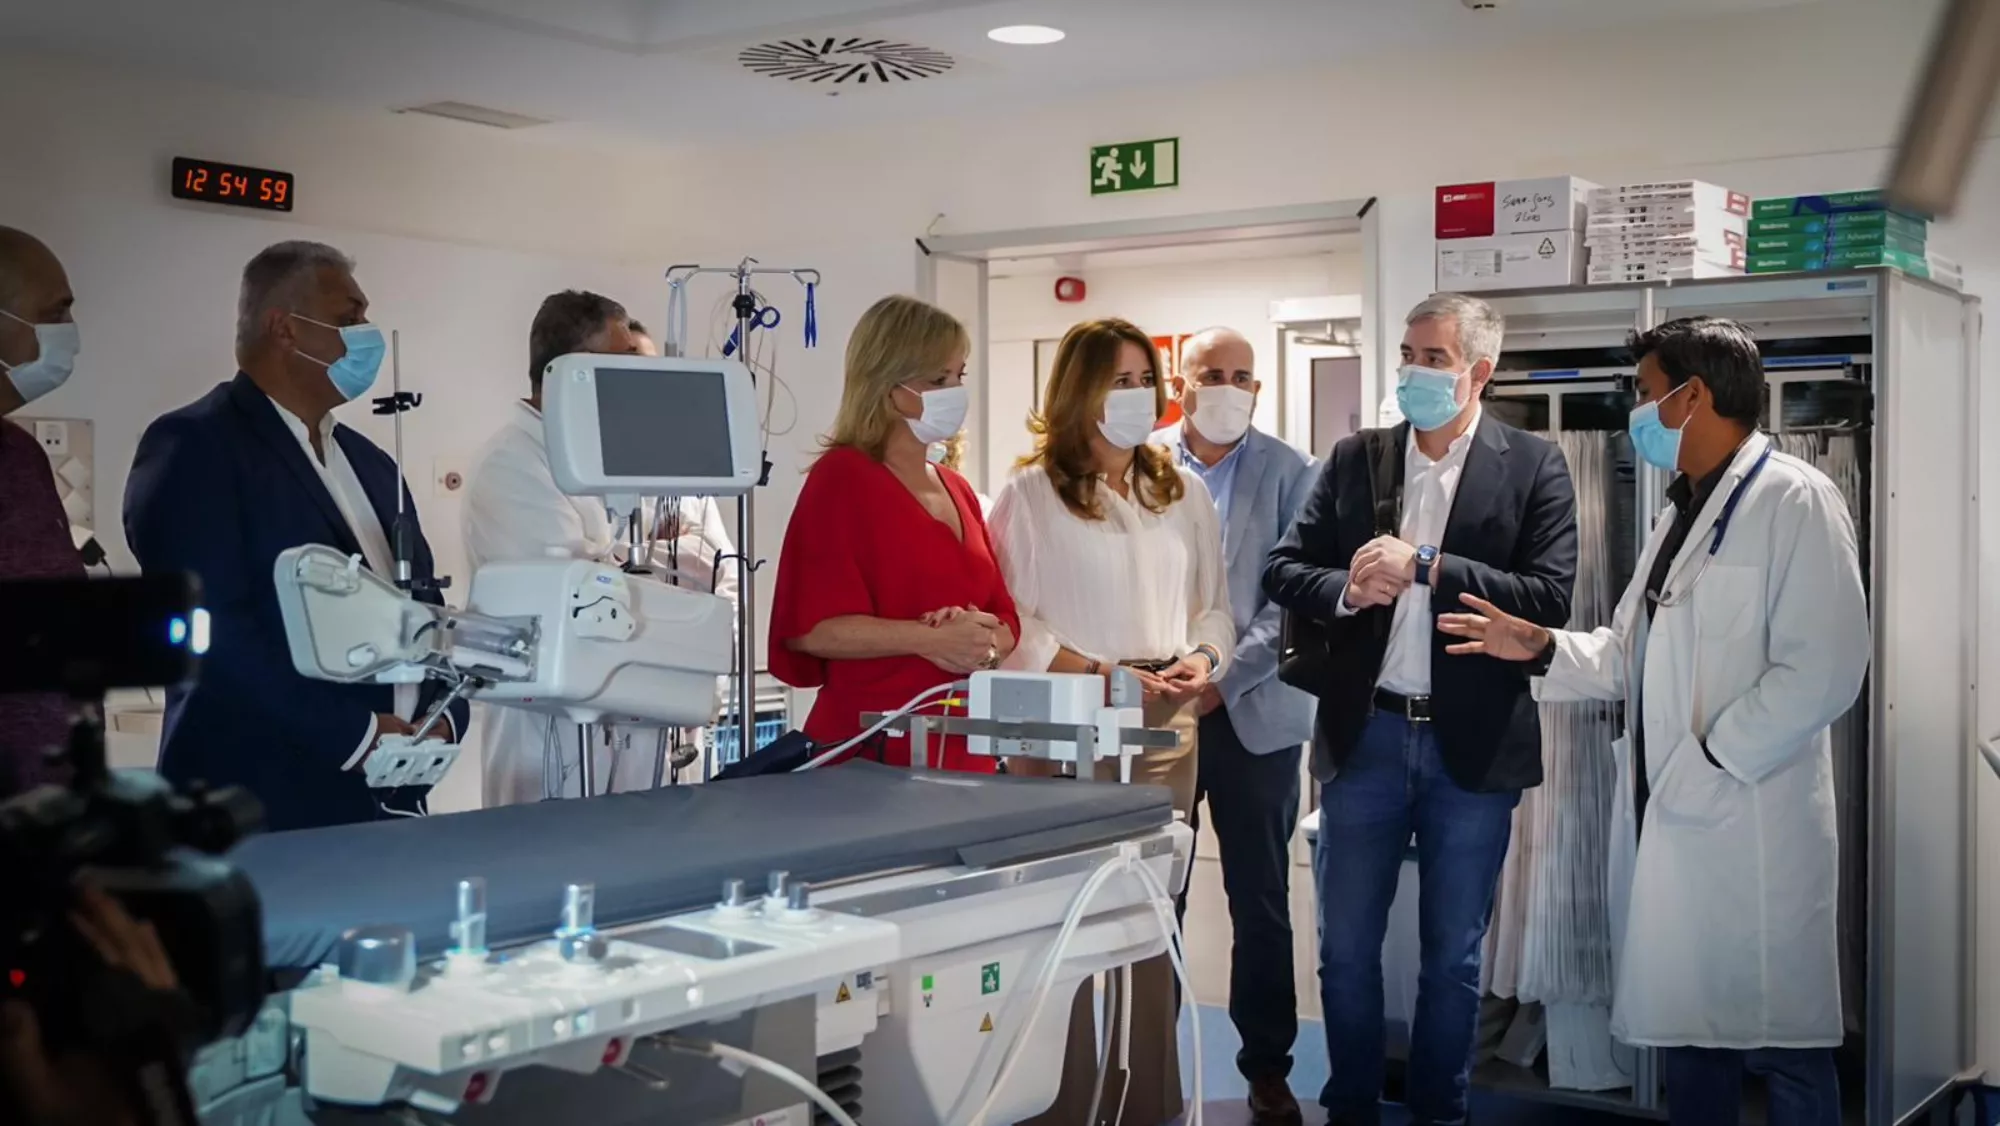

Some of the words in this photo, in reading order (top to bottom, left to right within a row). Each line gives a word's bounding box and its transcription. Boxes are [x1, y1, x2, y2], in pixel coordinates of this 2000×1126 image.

[185, 168, 208, 192] 12
[219, 172, 248, 196] 54
[260, 178, 288, 203] 59
